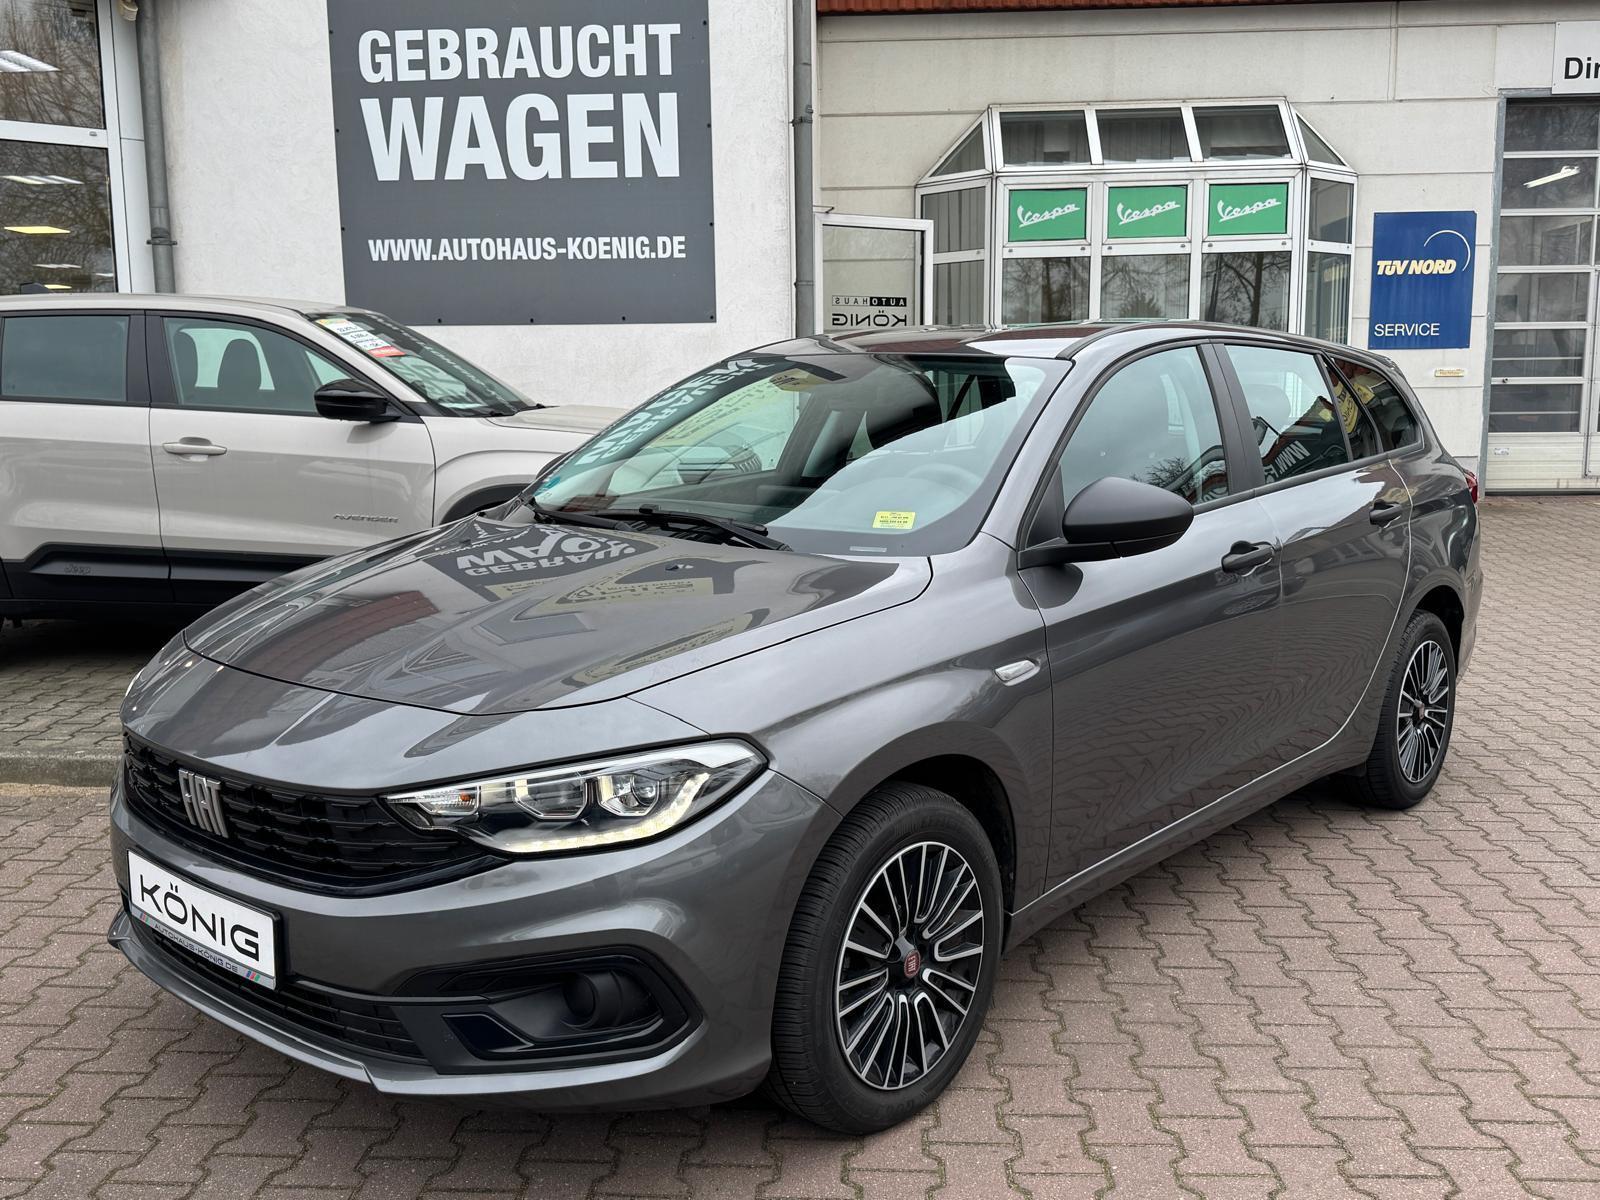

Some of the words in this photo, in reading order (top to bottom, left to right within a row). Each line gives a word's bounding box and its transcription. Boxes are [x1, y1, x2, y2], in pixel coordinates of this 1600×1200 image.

[358, 24, 681, 83] GEBRAUCHT
[359, 93, 680, 181] WAGEN
[1017, 203, 1080, 228] Vespa
[1117, 200, 1181, 226] Vespa
[1217, 198, 1281, 223] Vespa
[368, 236, 686, 262] WWW.AUTOHAUS-KOENIG.DE
[1377, 260, 1409, 276] TÜV
[1408, 259, 1457, 275] NORD
[1374, 323, 1440, 337] SERVICE
[334, 514, 398, 523] AVENGER
[178, 768, 229, 839] FIAT
[140, 874, 260, 962] KÖNIG
